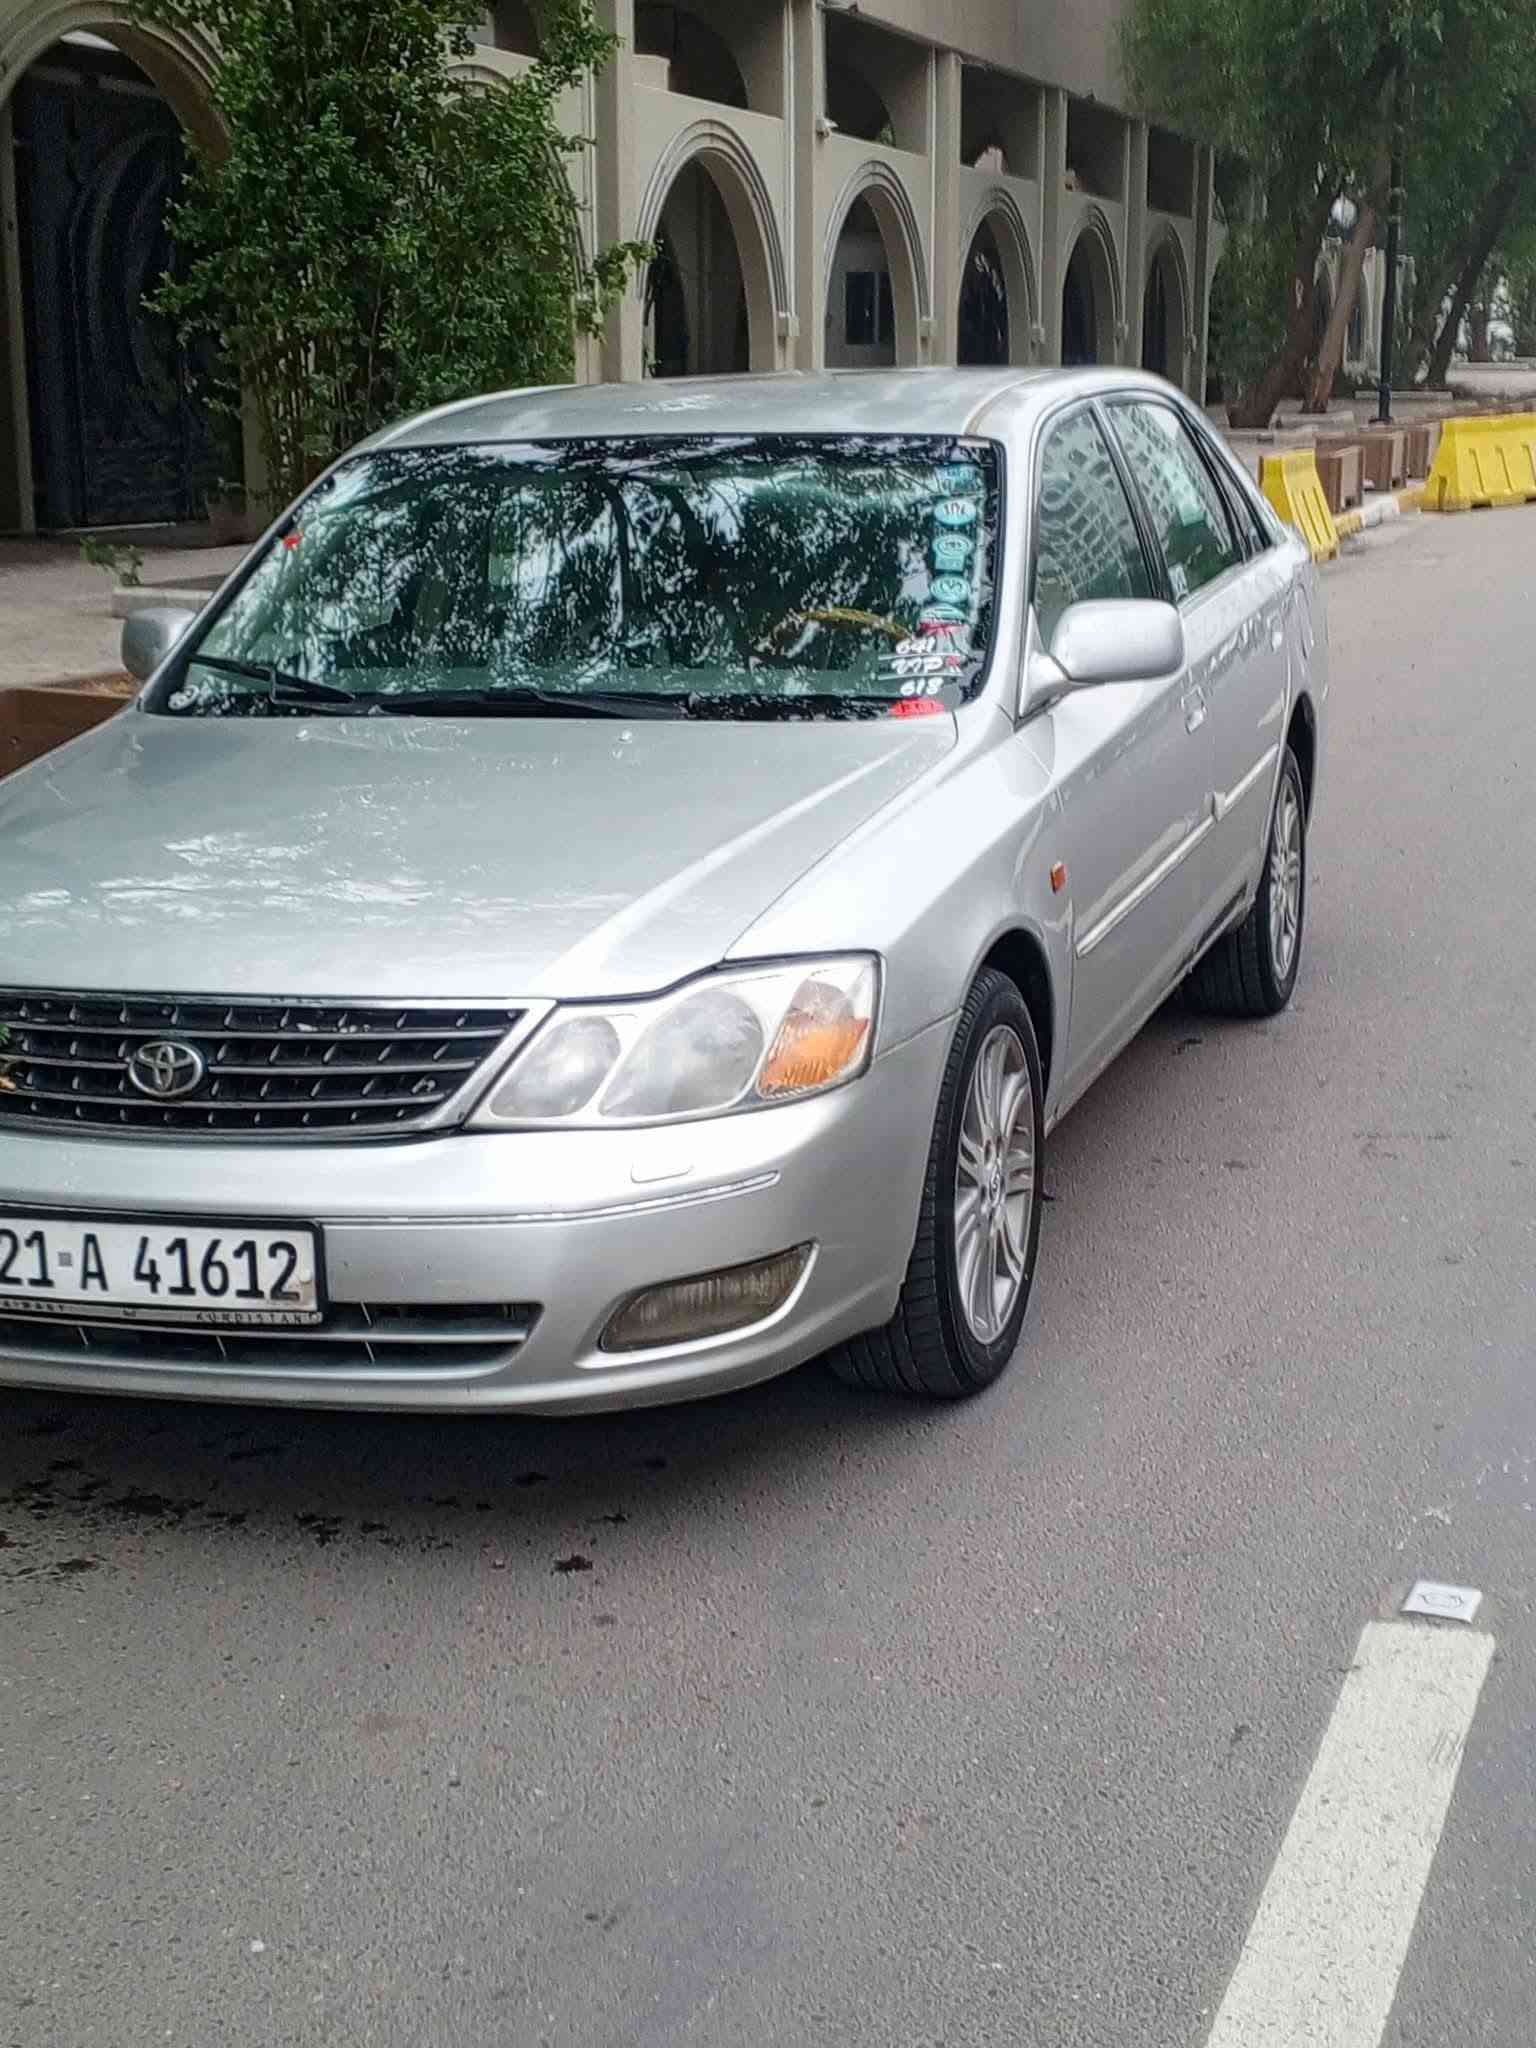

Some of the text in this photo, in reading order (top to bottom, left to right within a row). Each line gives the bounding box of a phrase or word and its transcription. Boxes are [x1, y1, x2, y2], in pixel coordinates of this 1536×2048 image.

[0, 1228, 300, 1301] 21 A 41612
